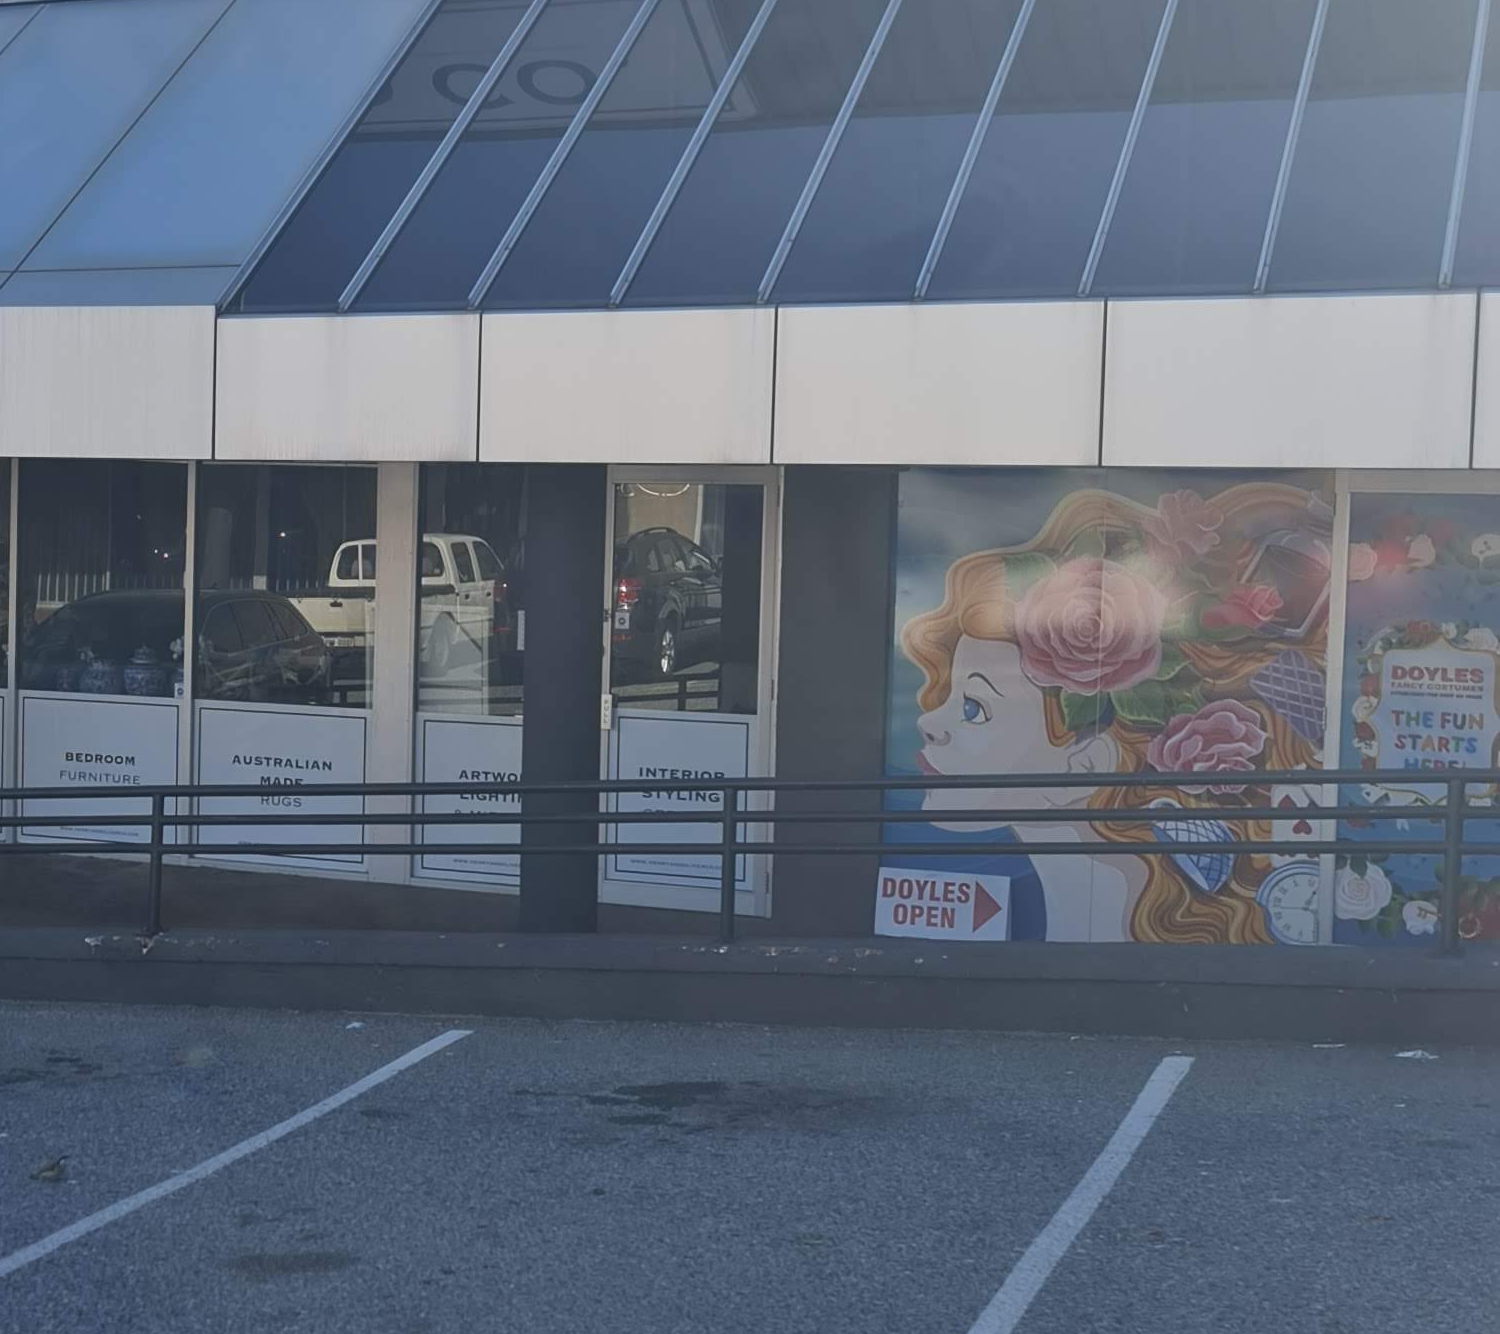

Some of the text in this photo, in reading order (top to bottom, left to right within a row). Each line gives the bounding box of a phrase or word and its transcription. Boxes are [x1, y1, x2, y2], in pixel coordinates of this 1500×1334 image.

[1391, 665, 1484, 684] DOYLES
[1391, 710, 1484, 730] THE FUN
[1394, 734, 1478, 754] STARTS
[65, 752, 136, 766] BEDROOM
[232, 754, 333, 771] AUSTRALIAN
[60, 770, 141, 785] FURNITURE
[459, 770, 519, 783] ARTWO
[639, 767, 725, 779] INTERIOR
[260, 776, 304, 787] MADE
[260, 795, 302, 807] RUGS
[882, 877, 971, 904] DOYLES
[892, 903, 956, 928] OPEN
